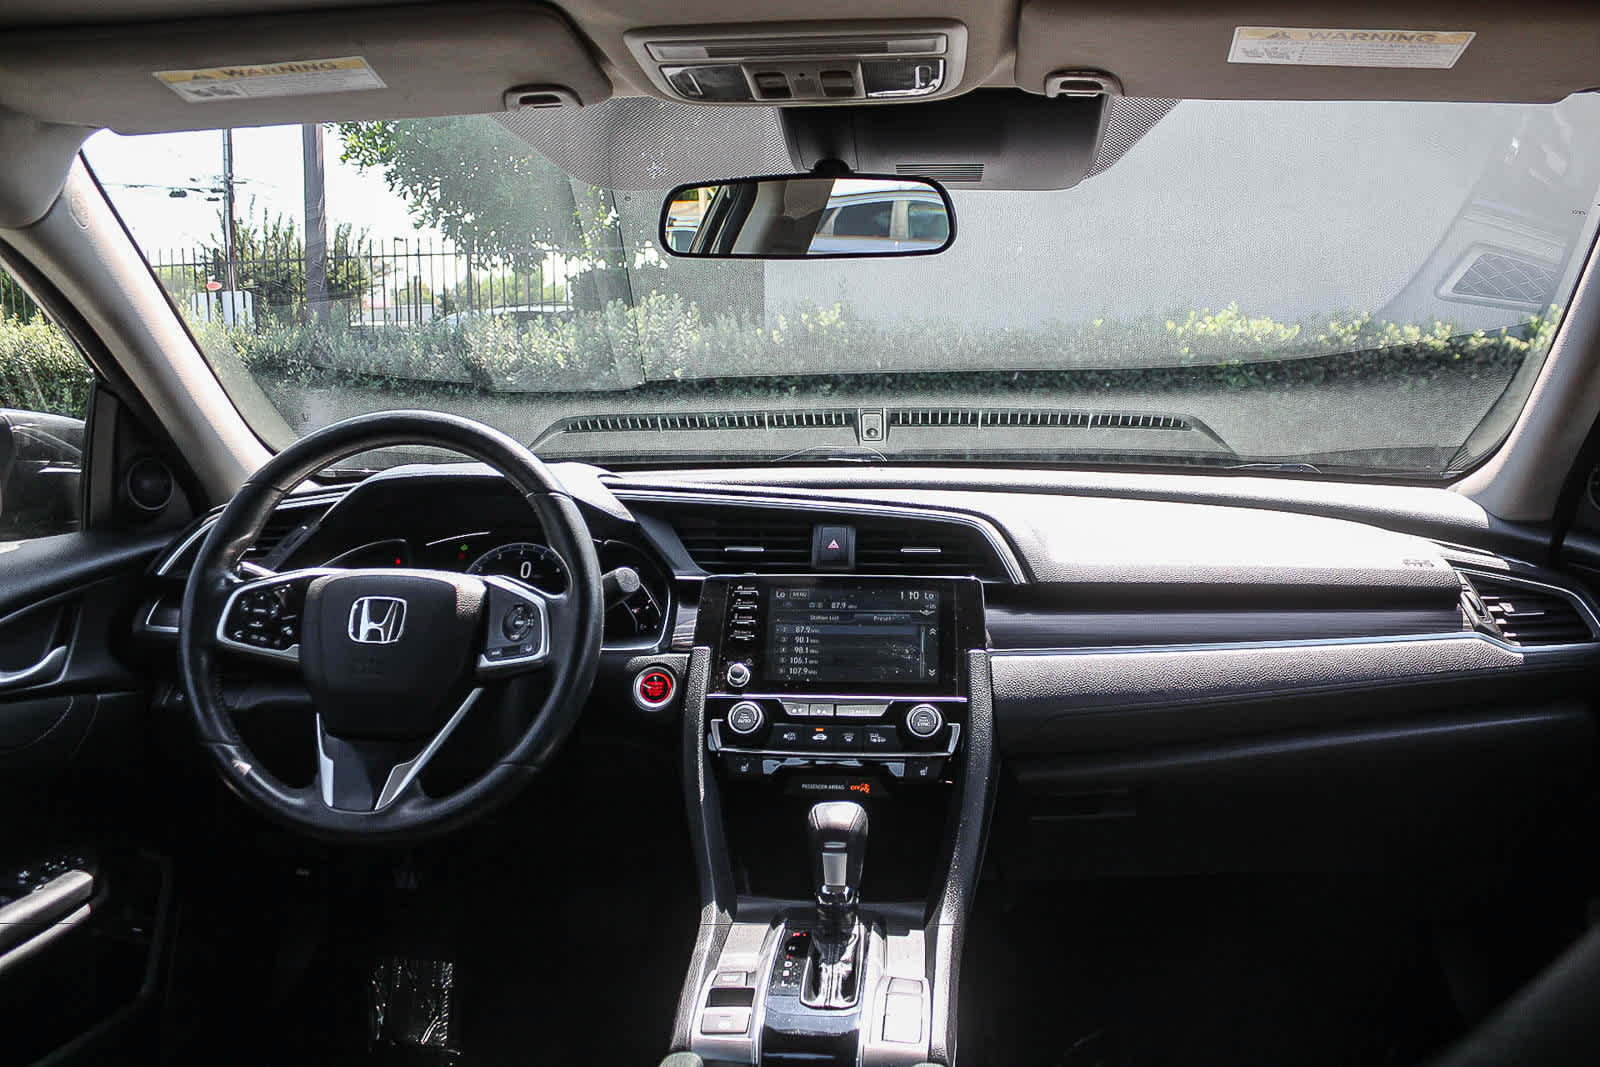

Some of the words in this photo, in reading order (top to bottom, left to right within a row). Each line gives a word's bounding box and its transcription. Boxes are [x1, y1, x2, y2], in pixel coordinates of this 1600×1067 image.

[1307, 31, 1438, 42] WARNING
[521, 561, 532, 579] 0
[795, 625, 811, 633] 87.9
[790, 656, 808, 665] 106.1
[789, 667, 809, 675] 107.9
